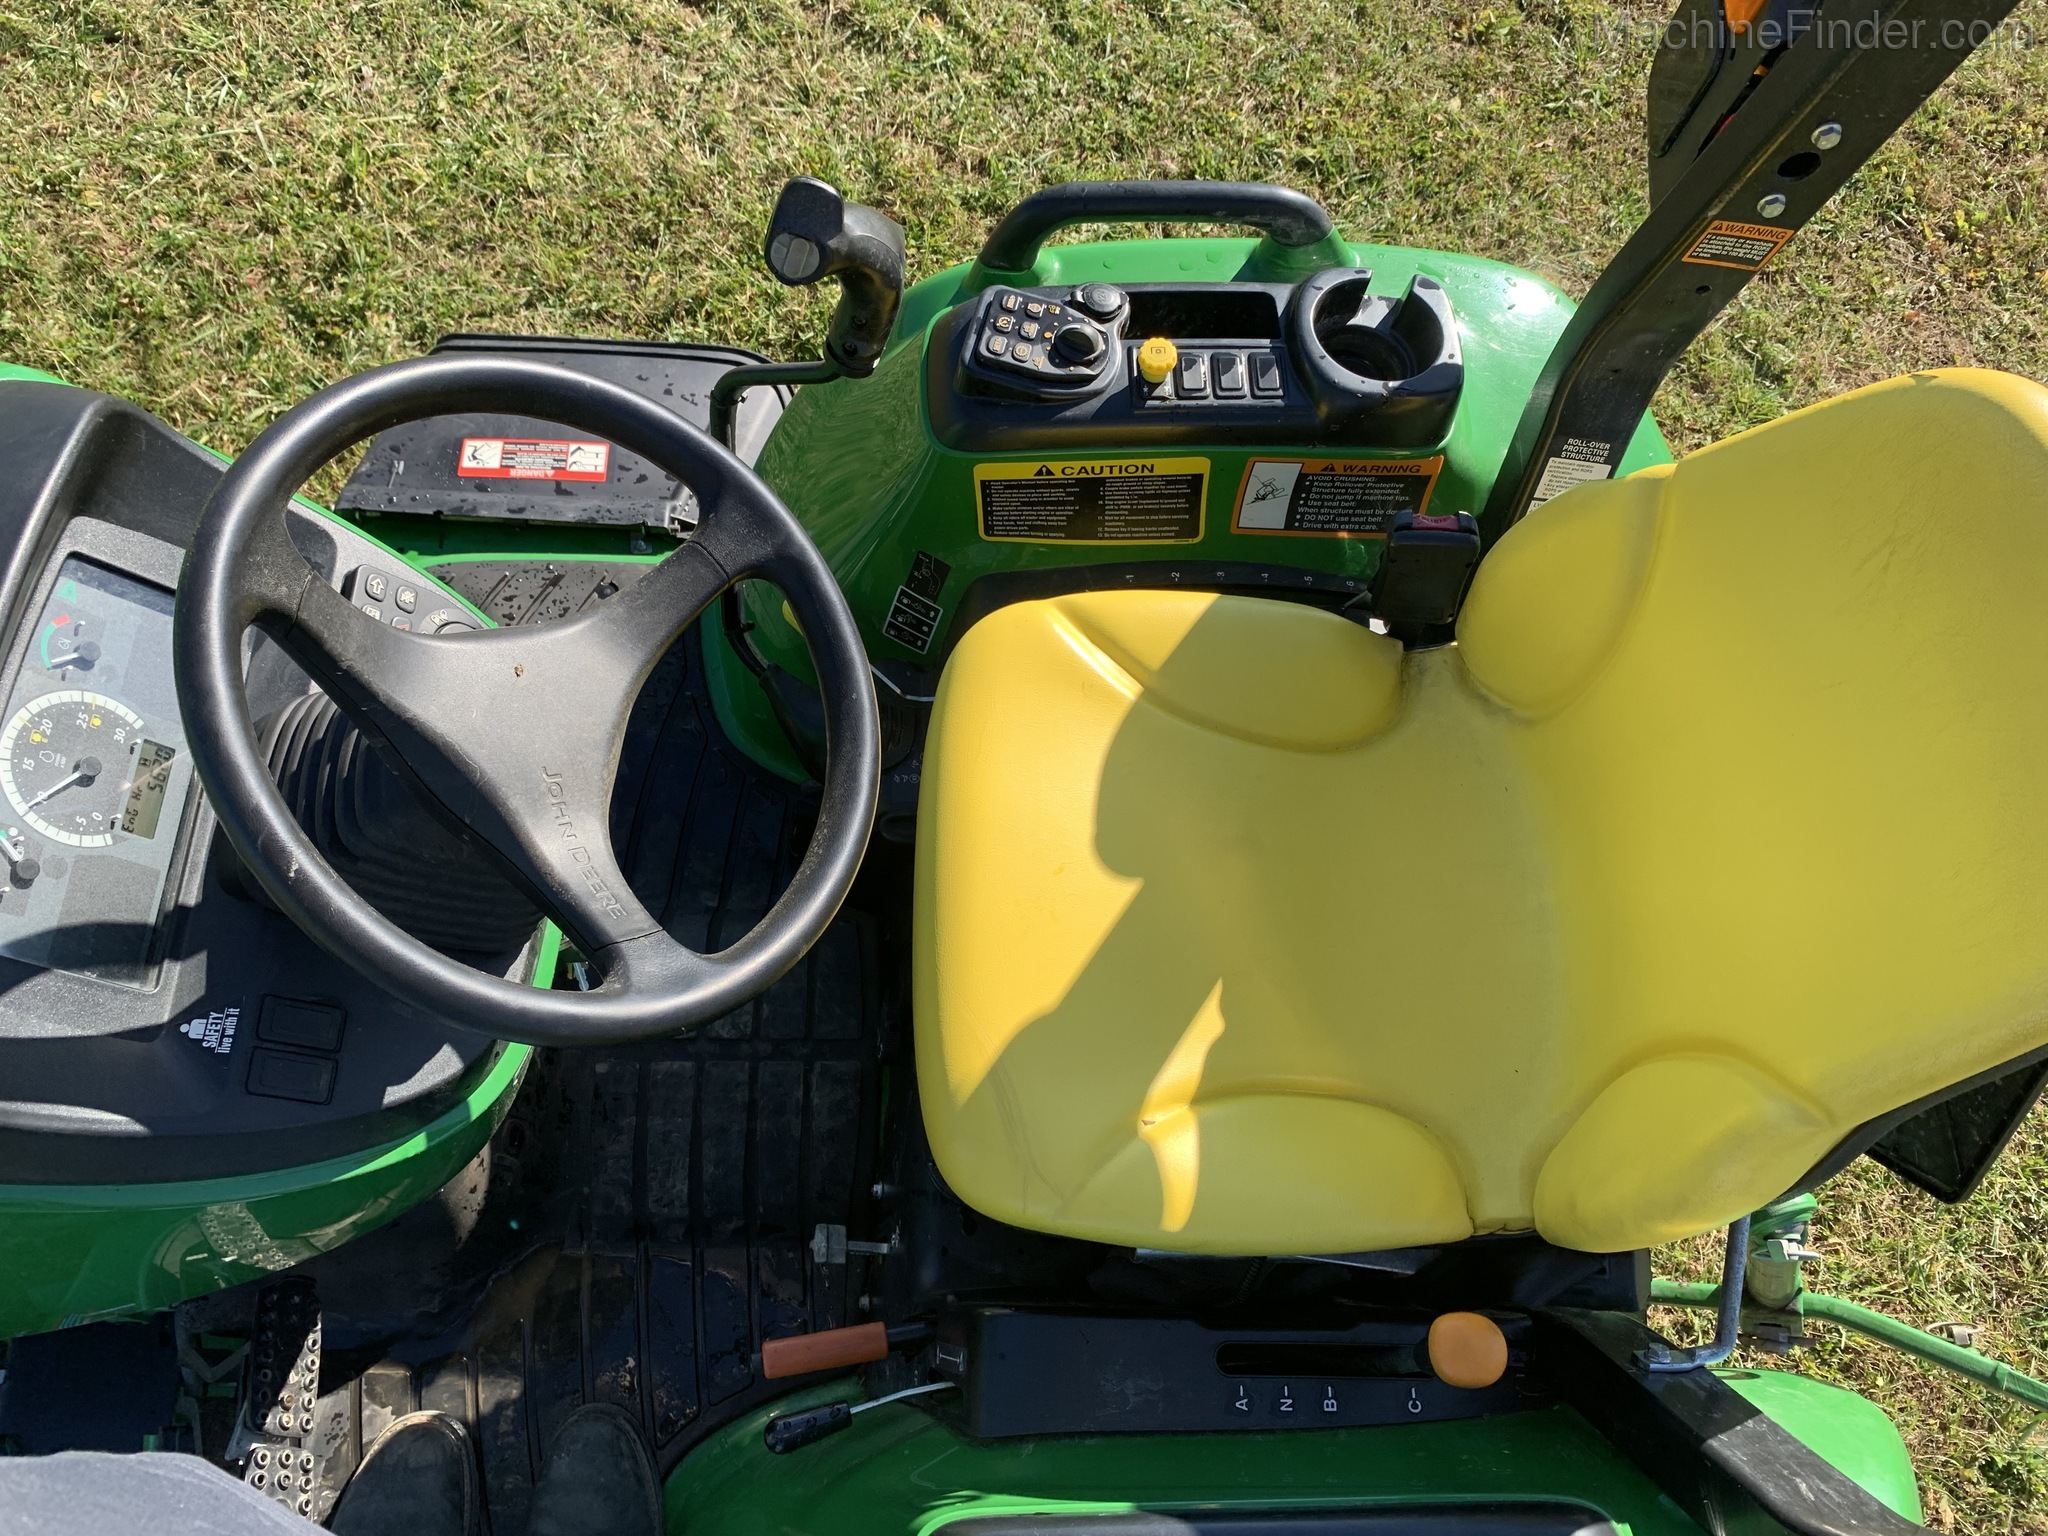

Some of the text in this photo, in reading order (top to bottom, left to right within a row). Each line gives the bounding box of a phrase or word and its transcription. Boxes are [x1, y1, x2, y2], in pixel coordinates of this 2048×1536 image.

[1725, 224, 1787, 240] WARNING
[1563, 445, 1609, 456] PROTECTIVE
[1567, 438, 1610, 450] ROLL-OVER
[1561, 452, 1605, 463] STRUCTURE
[510, 469, 544, 478] DANGER
[1061, 464, 1155, 476] CAUTION
[1342, 464, 1422, 474] WARNING
[40, 719, 53, 735] 20
[76, 712, 88, 729] 25
[114, 729, 125, 743] 30
[23, 757, 35, 771] 15
[76, 816, 86, 825] 5
[92, 812, 102, 821] 0
[542, 766, 627, 919] JOHN DEERE
[202, 1011, 223, 1048] SAFETY
[224, 1017, 238, 1035] with
[217, 1037, 233, 1053] live
